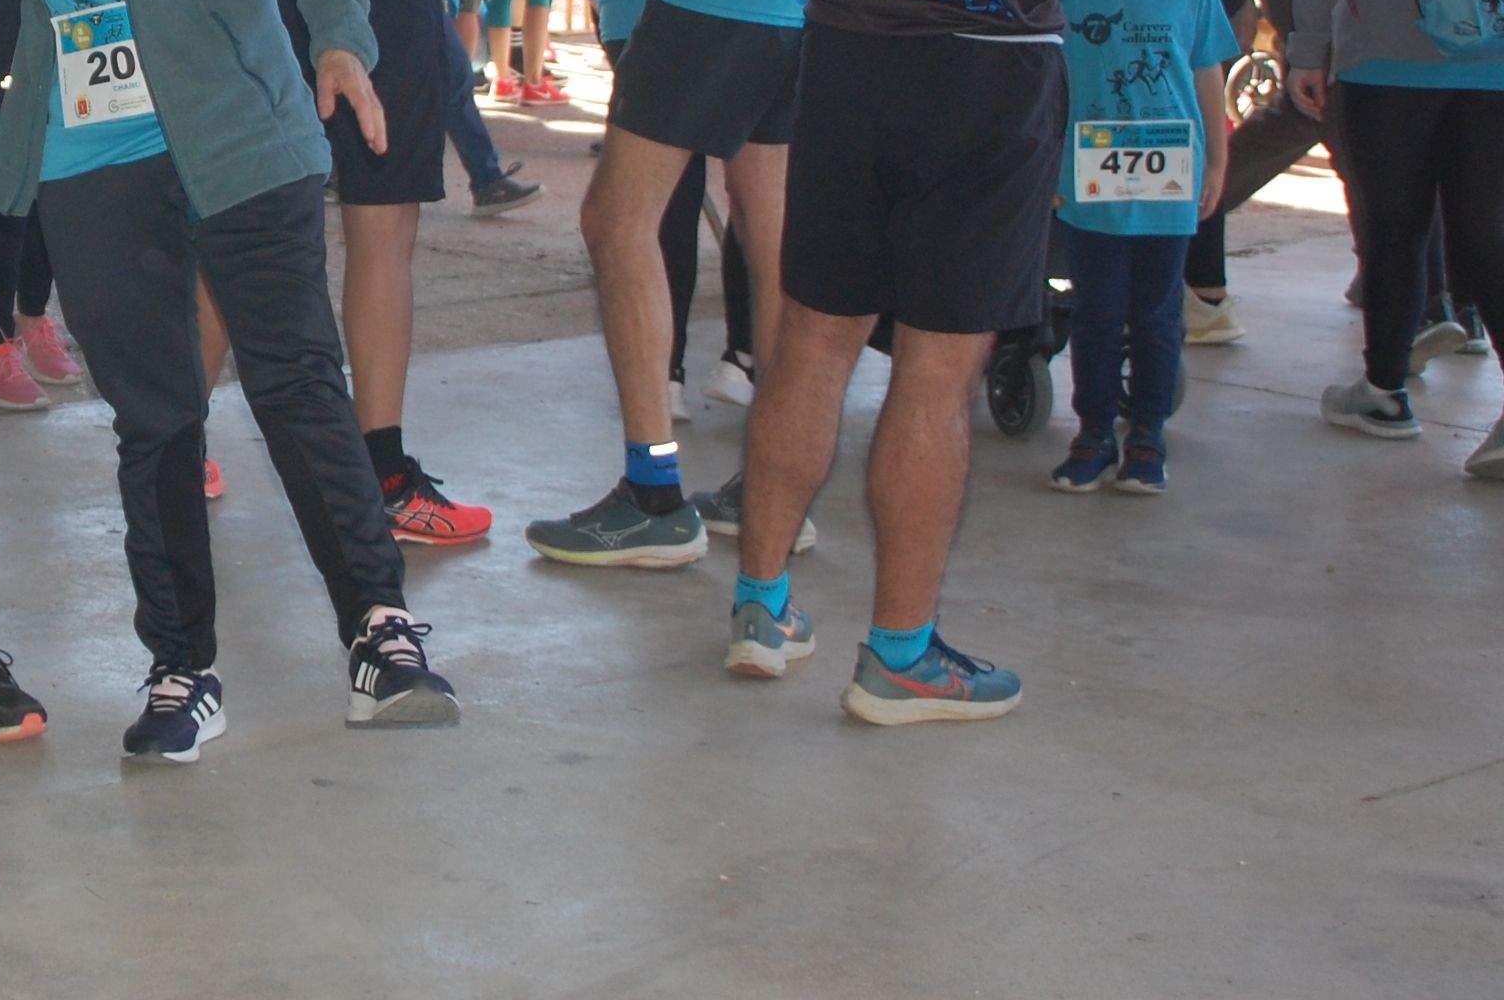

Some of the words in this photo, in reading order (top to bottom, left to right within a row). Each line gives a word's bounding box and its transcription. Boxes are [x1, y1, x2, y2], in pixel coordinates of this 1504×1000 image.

[1123, 21, 1172, 32] Carrera
[87, 46, 136, 86] 20
[1100, 150, 1166, 174] 470
